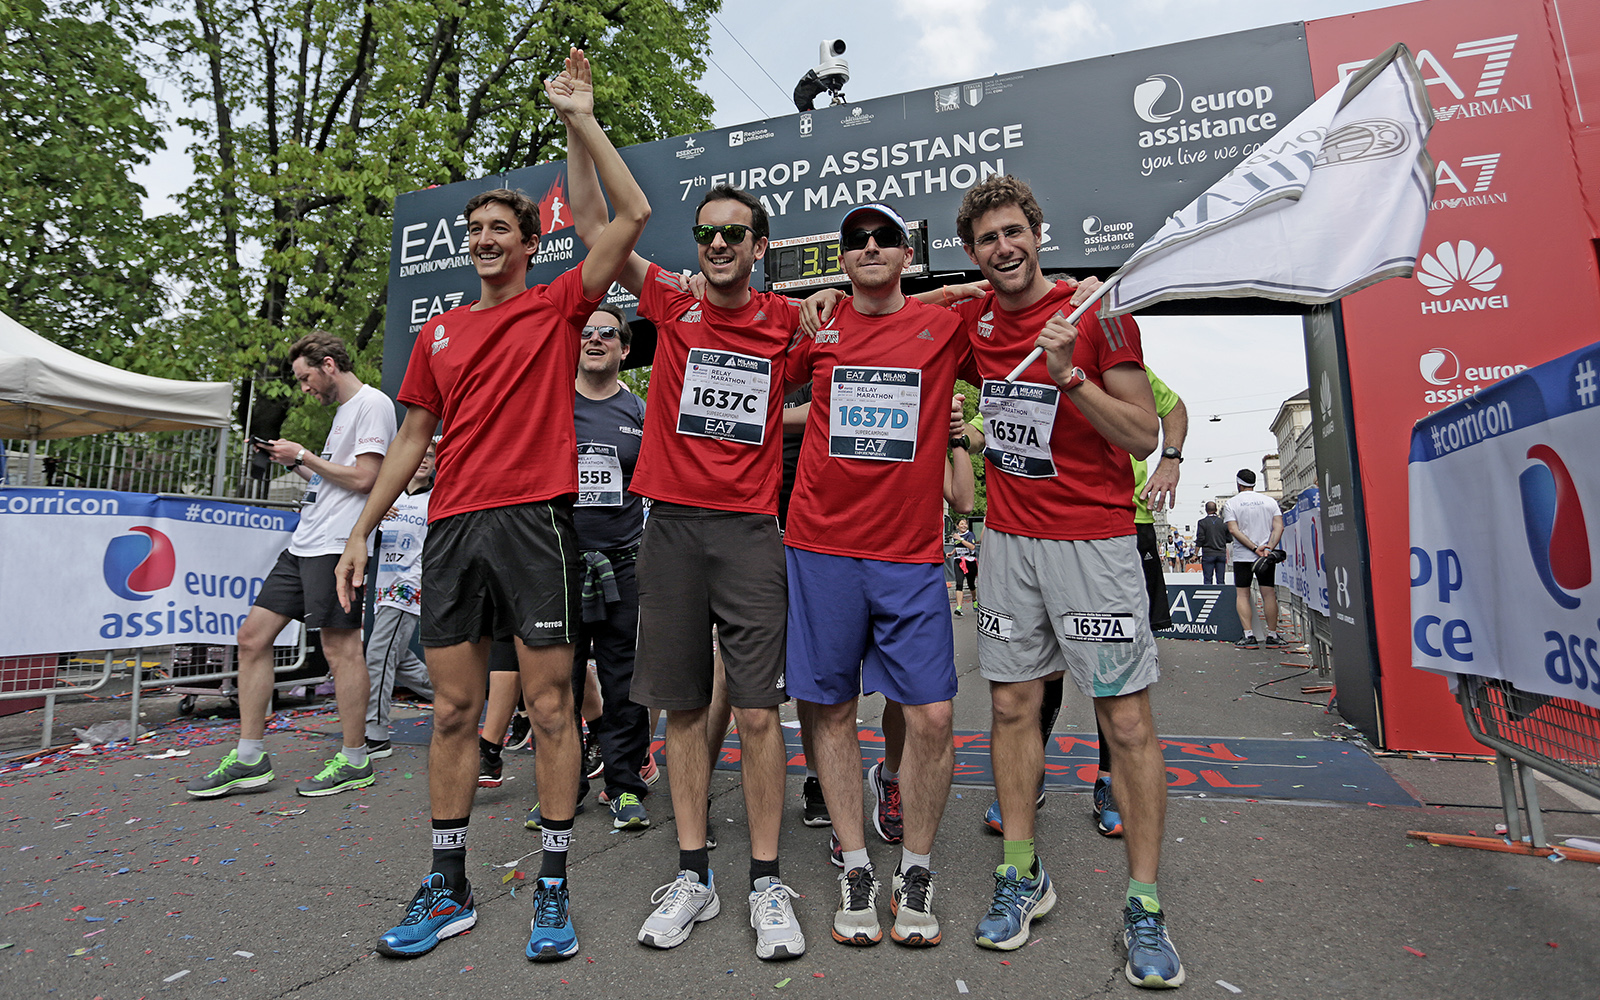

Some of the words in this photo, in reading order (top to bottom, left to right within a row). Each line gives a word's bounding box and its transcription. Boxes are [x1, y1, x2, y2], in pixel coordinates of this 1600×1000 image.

[1191, 85, 1273, 114] europ
[1456, 94, 1533, 119] ARMANI
[743, 128, 768, 137] Regione
[743, 132, 775, 143] Lombardia
[1138, 111, 1277, 148] assistance
[679, 174, 707, 201] 7th
[710, 160, 811, 191] EUROP
[819, 123, 1024, 178] ASSISTANCE
[1140, 155, 1173, 176] you
[1177, 147, 1208, 166] live
[1214, 143, 1239, 160] we
[1242, 141, 1265, 156] ca
[1435, 152, 1502, 194] A7
[804, 158, 1005, 211] MARATHON
[1460, 192, 1508, 208] ARMANI
[1103, 221, 1134, 234] europ
[538, 236, 574, 255] LANO
[771, 240, 784, 248] TDS
[785, 237, 805, 246] TIMING
[805, 235, 818, 243] DATA
[819, 232, 841, 240] SERVIC
[931, 236, 963, 249] GAR
[1084, 230, 1135, 245] assistance
[531, 250, 573, 264] ARATHON
[1084, 246, 1098, 256] you
[1098, 243, 1110, 252] live
[1110, 243, 1120, 251] we
[399, 261, 437, 277] EMPORIO
[447, 254, 475, 269] ARMA
[788, 279, 808, 287] TIMING
[808, 277, 821, 285] DATA
[822, 275, 845, 283] SERVICE
[411, 291, 465, 324] EA7
[1420, 295, 1509, 315] HUAWEI
[701, 353, 721, 364] EA7
[737, 358, 758, 367] MILANO
[710, 375, 746, 385] MARATHON
[711, 369, 732, 377] RELAY
[846, 371, 865, 379] EA7
[882, 372, 907, 380] MILANO
[856, 392, 894, 400] MARATHON
[990, 384, 1006, 394] EA7
[1019, 386, 1043, 396] MILANO
[692, 386, 758, 414] 1637C
[838, 405, 909, 429] 1637D
[1001, 406, 1028, 416] MARATHON
[704, 418, 737, 434] EA7
[989, 418, 1041, 448] 1637A
[1430, 400, 1514, 456] #corricon
[854, 438, 887, 453] EA7
[1001, 452, 1027, 469] EA7
[579, 492, 602, 502] EA7
[185, 503, 285, 531] #corricon
[185, 571, 265, 607] europ
[1168, 589, 1222, 623] A7
[1073, 617, 1125, 637] 1637A
[1186, 625, 1218, 635] ARMANI
